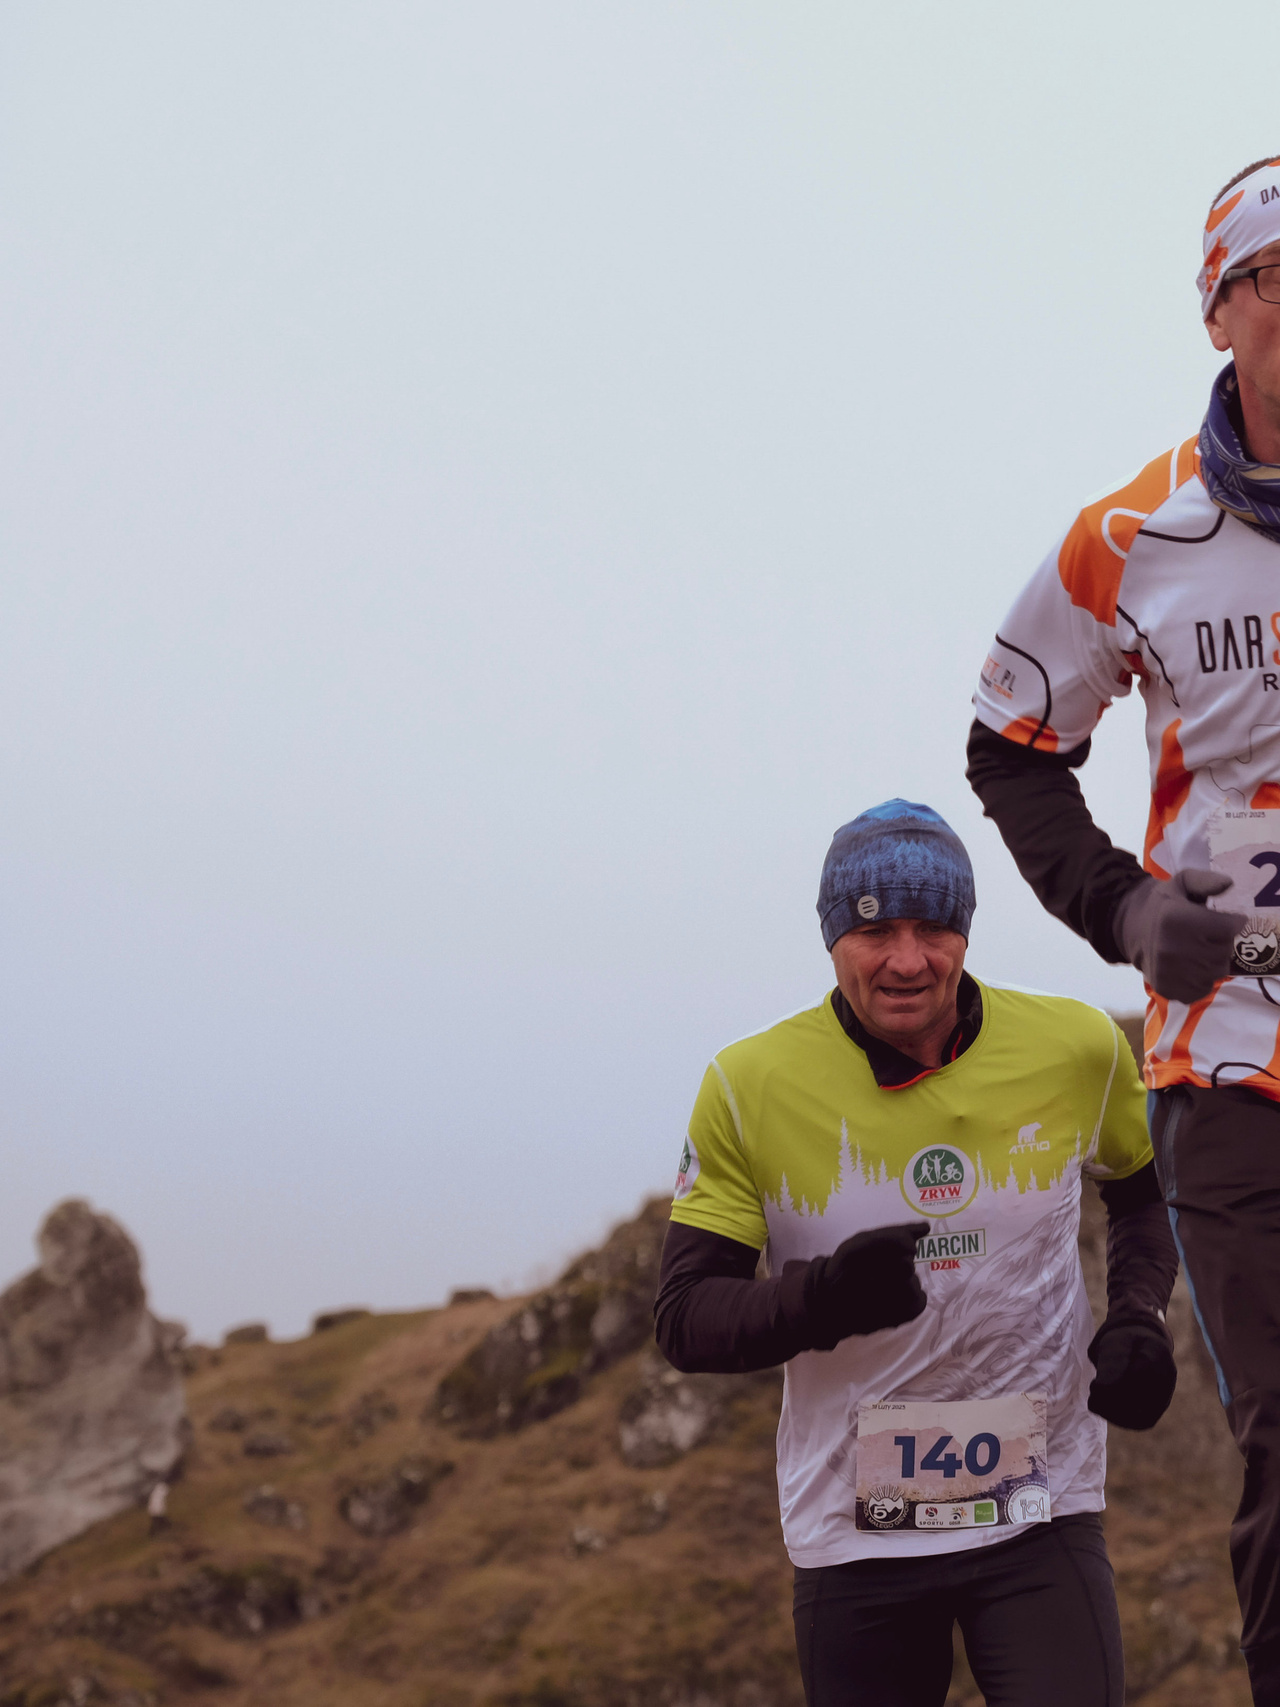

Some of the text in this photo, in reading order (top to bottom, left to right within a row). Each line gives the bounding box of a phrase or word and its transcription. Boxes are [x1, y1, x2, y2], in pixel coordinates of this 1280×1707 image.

[1240, 943, 1258, 962] 5
[919, 1183, 962, 1201] ZRYW
[916, 1233, 980, 1260] MARCIN
[930, 1259, 961, 1271] DZIK
[894, 1432, 1001, 1479] 140
[873, 1505, 888, 1520] 5
